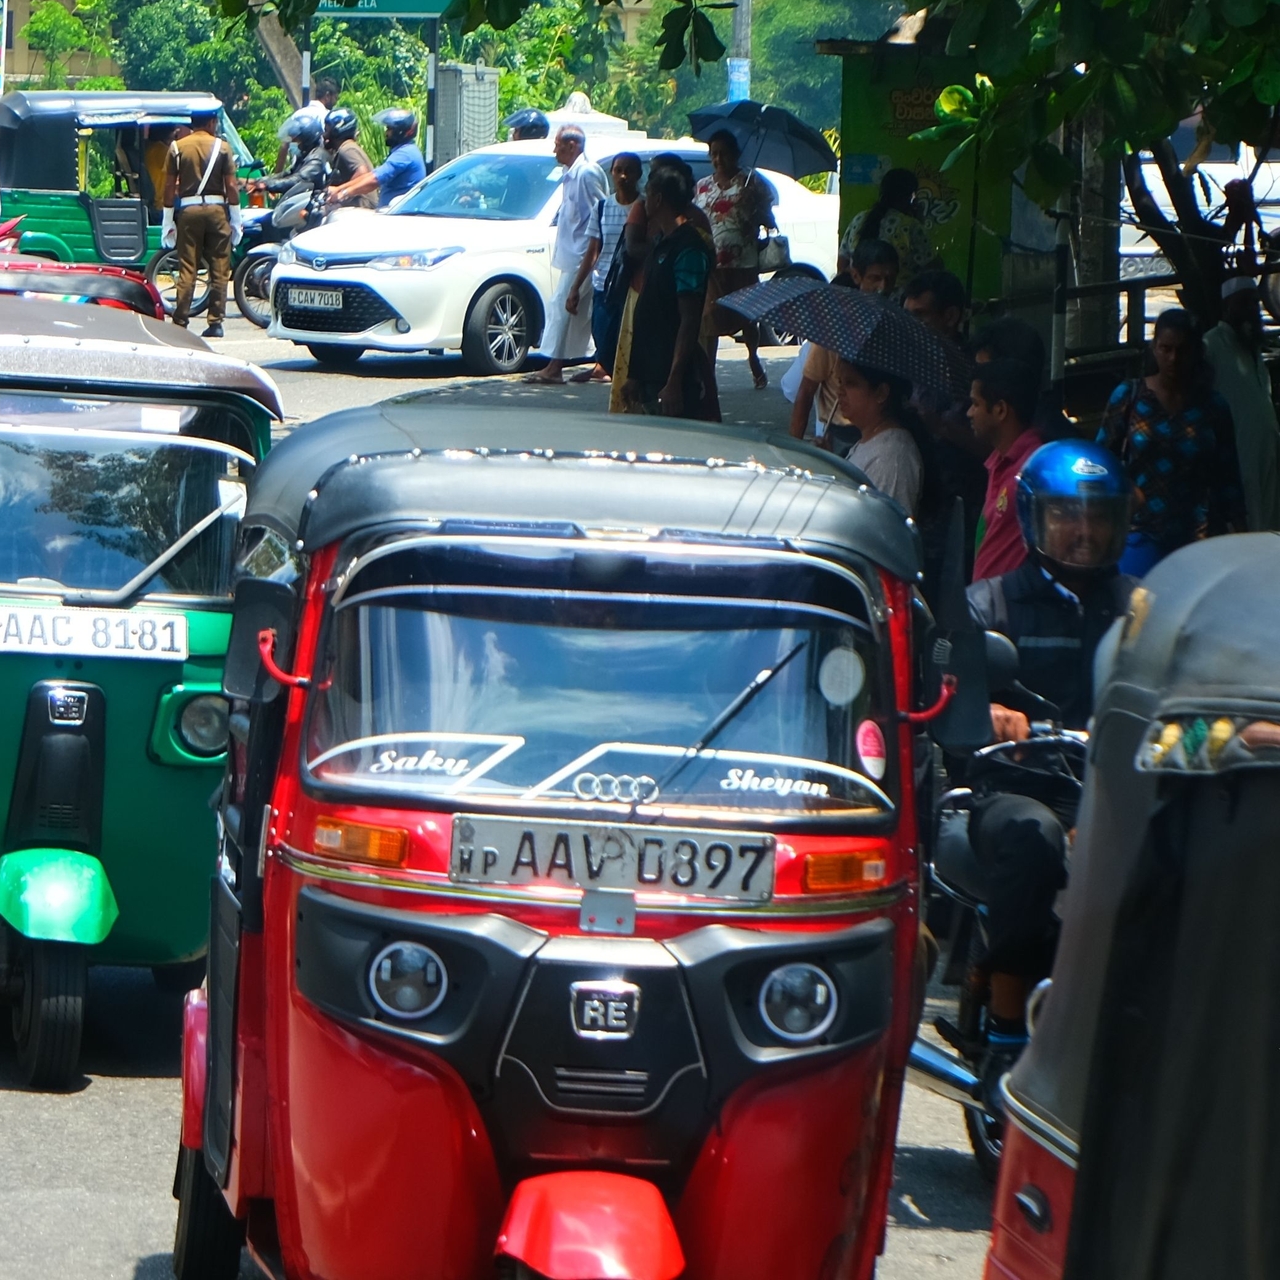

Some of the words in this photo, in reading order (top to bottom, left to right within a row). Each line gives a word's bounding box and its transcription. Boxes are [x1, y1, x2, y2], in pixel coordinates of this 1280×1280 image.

[297, 290, 316, 305] CAW
[317, 292, 341, 307] 7018
[2, 612, 74, 647] AAC
[91, 616, 182, 653] 8181
[370, 749, 471, 777] Saky
[719, 768, 831, 797] Sheyan
[457, 846, 500, 876] WP
[637, 837, 771, 892] 0897
[583, 1000, 629, 1028] RE
